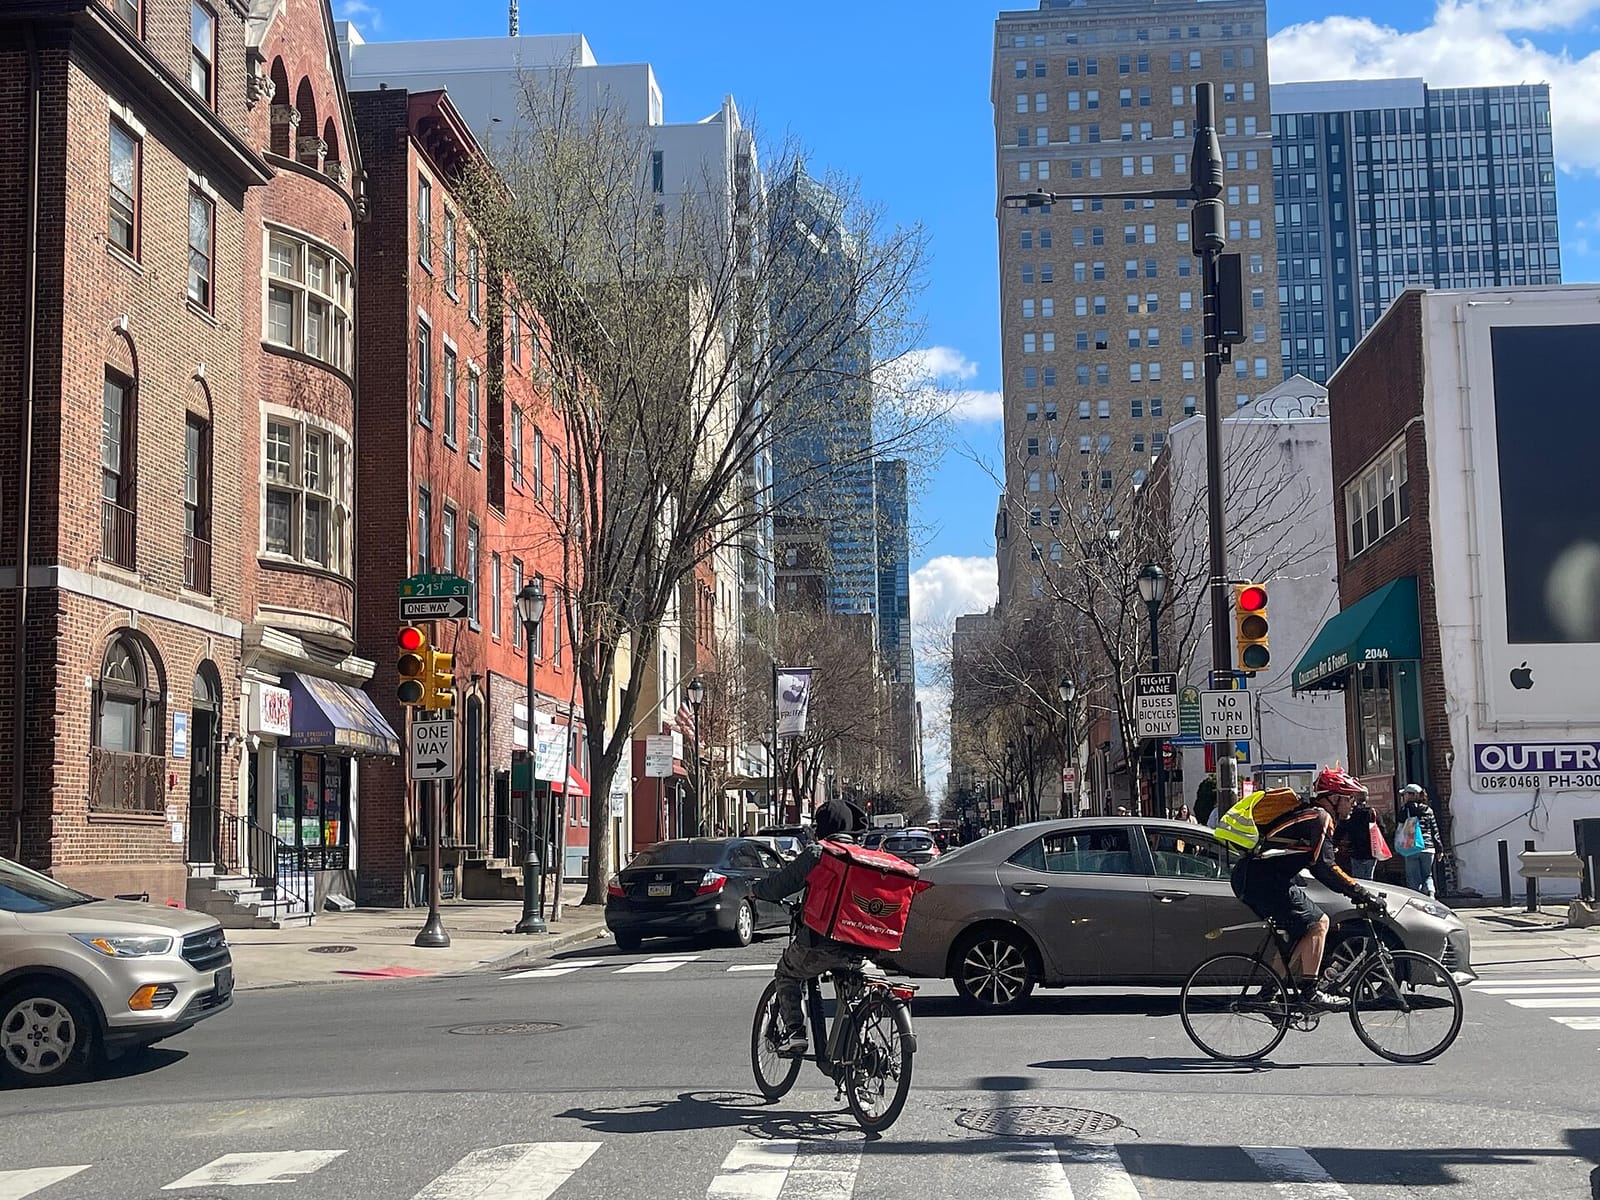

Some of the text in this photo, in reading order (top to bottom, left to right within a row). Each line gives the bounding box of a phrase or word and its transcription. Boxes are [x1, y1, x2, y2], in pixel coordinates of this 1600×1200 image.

[416, 582, 467, 596] 21ST ST
[408, 603, 448, 614] ONE WAY
[1365, 648, 1388, 659] 2044
[1140, 676, 1172, 686] RIGHT
[1143, 685, 1170, 694] LANE
[1142, 698, 1172, 708] BUSES
[1218, 697, 1236, 707] NO
[1140, 710, 1176, 720] BICYCLES
[1210, 711, 1242, 721] TURN
[417, 726, 448, 739] ONE
[1145, 722, 1172, 733] ONLY
[1205, 725, 1248, 735] ON RED
[416, 742, 448, 754] WAY
[1480, 744, 1600, 770] OUTFR
